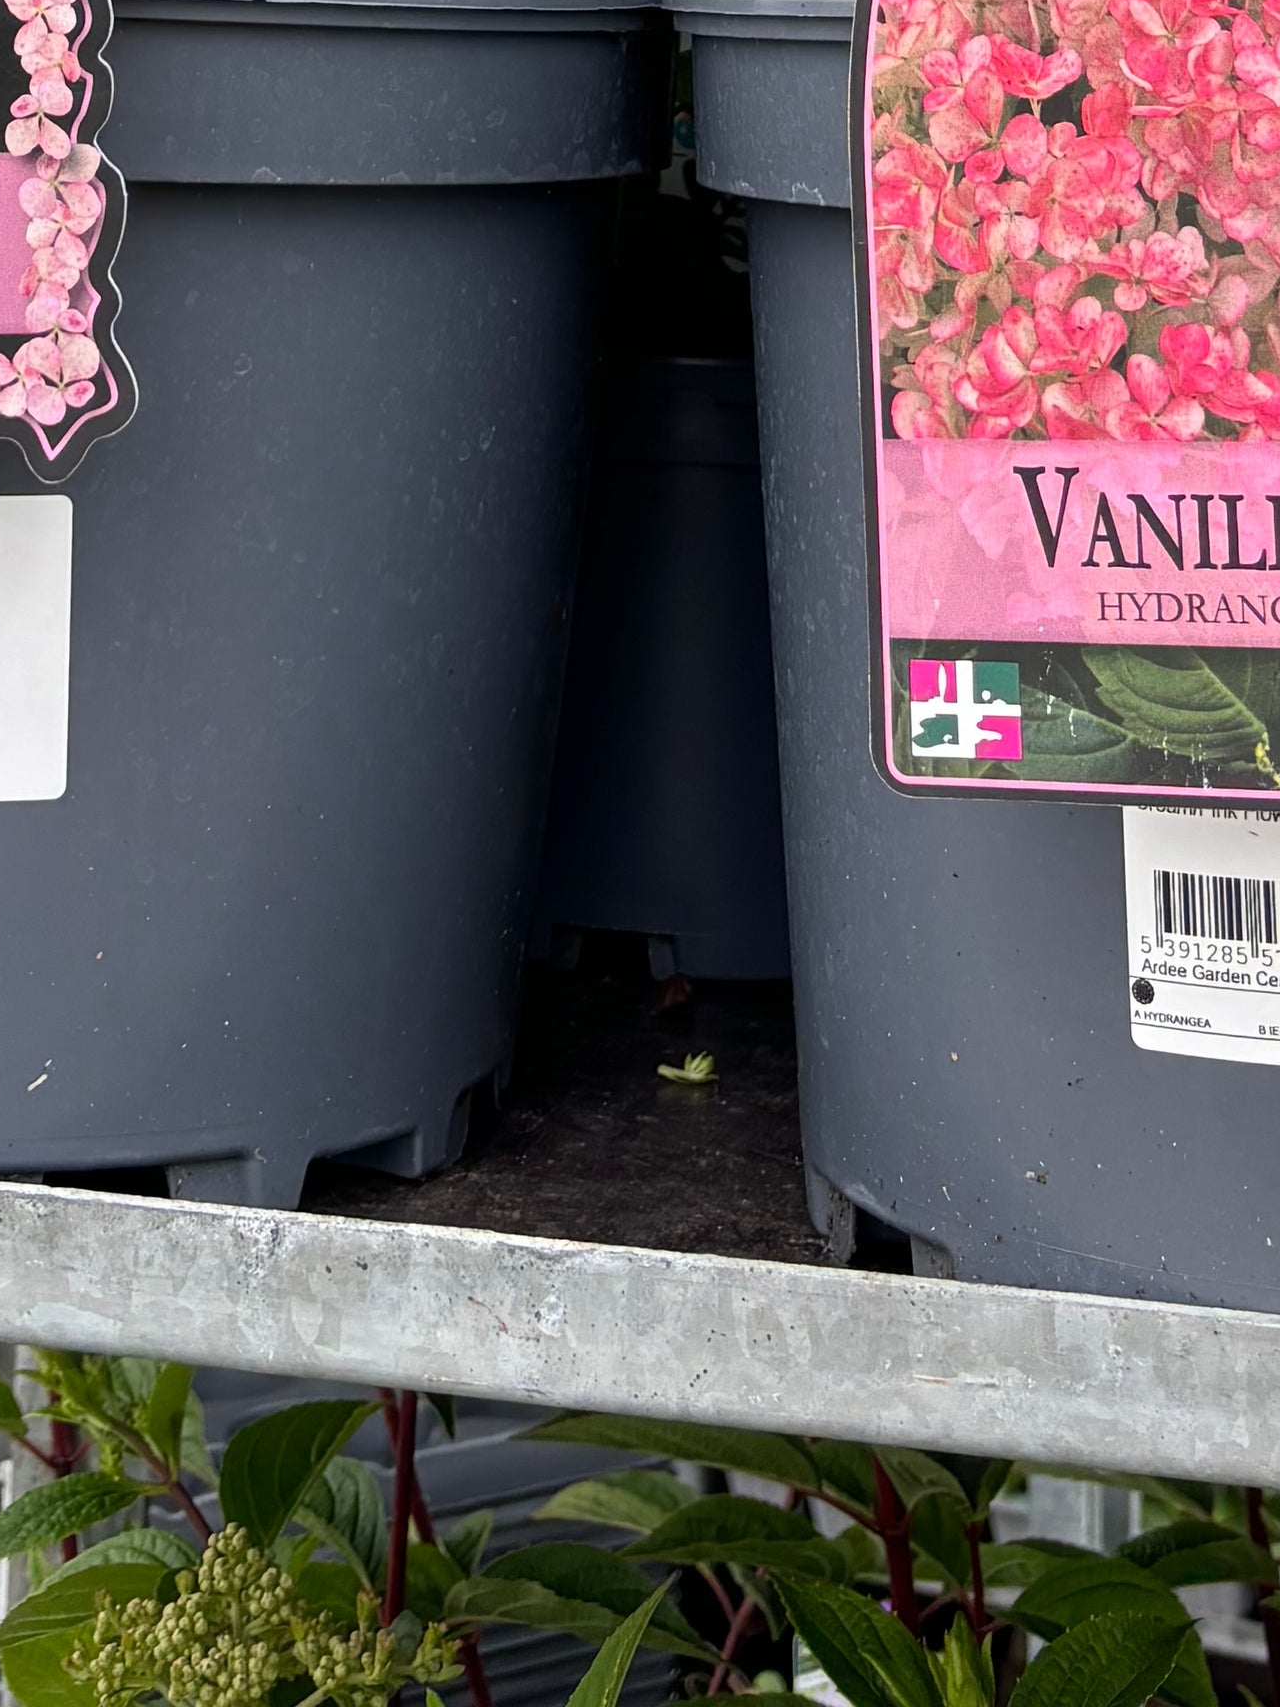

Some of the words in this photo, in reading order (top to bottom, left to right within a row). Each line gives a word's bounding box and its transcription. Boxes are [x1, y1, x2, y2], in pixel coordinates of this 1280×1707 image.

[1163, 939, 1249, 965] 391285
[1141, 958, 1187, 978] Ardee
[1192, 964, 1251, 986] Garden
[1134, 1010, 1142, 1019] A
[1144, 1011, 1212, 1029] HYDRANGEA
